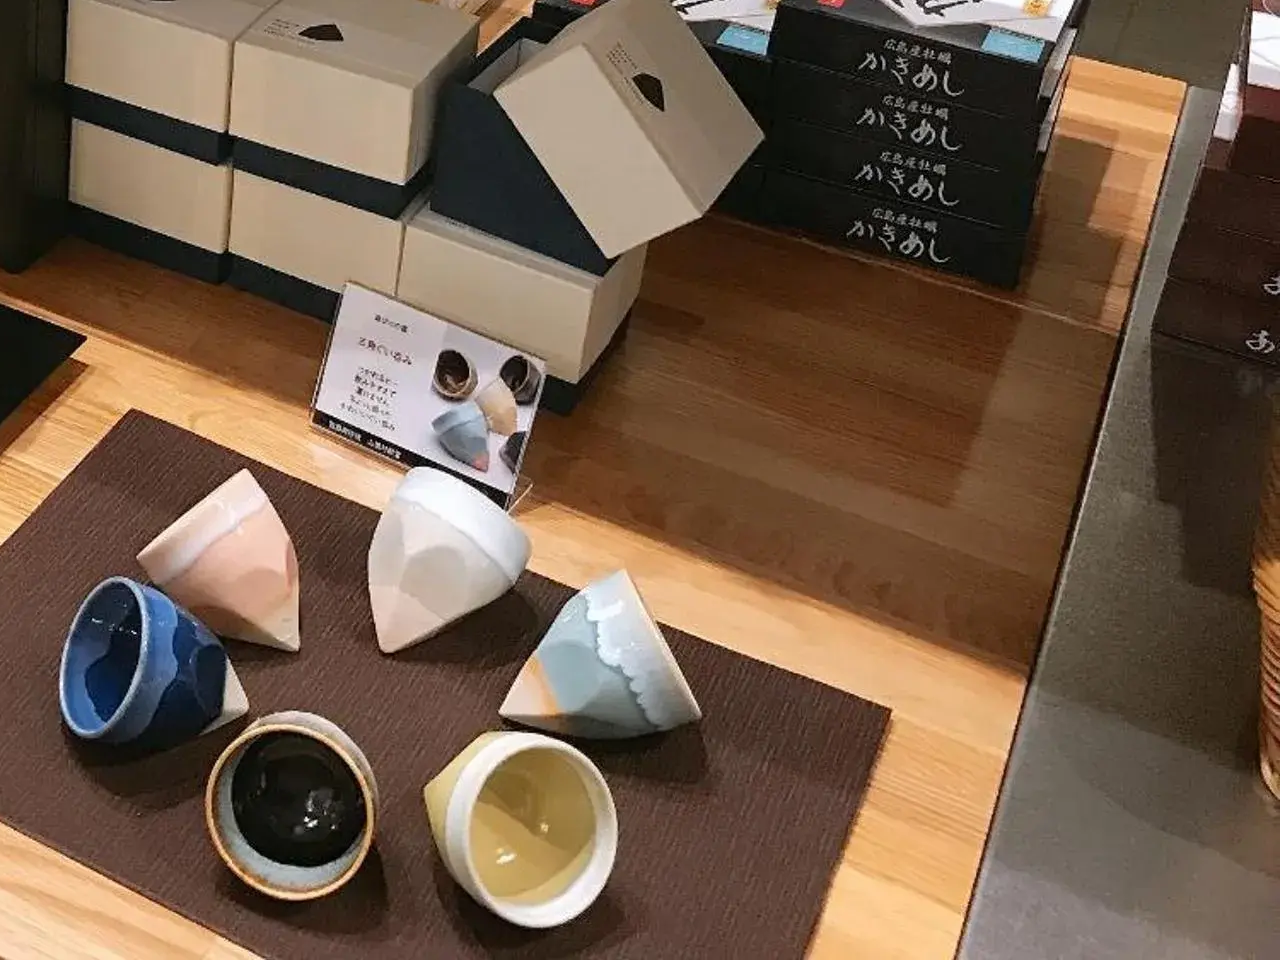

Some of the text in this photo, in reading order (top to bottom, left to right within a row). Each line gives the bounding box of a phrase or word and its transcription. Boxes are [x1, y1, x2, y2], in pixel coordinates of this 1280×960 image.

[858, 51, 965, 97] かきめし
[856, 107, 962, 151] かきめし
[855, 164, 960, 206] かきめし
[846, 220, 952, 263] かきめし
